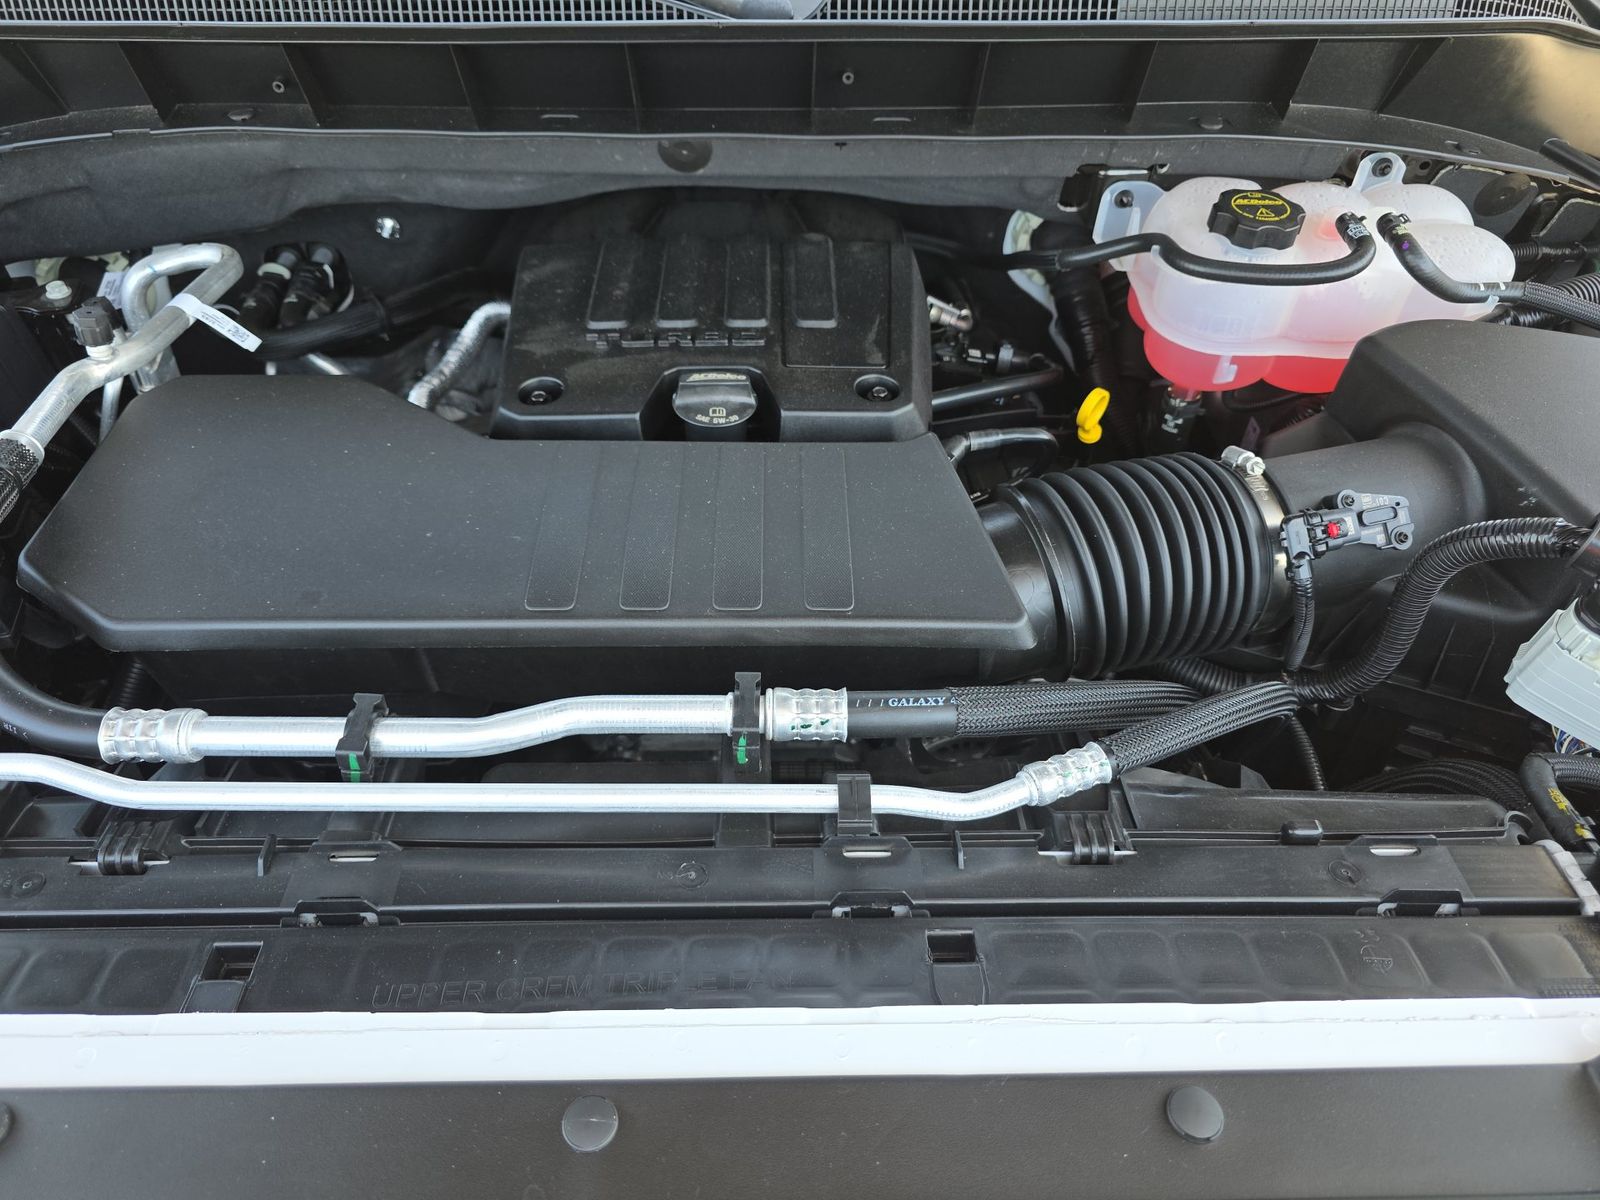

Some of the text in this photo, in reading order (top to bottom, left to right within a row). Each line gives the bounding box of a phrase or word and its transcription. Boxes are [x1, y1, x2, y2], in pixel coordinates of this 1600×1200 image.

[888, 697, 946, 707] GALAXY
[371, 980, 487, 1008] UPPER
[496, 974, 593, 1001] CRFM
